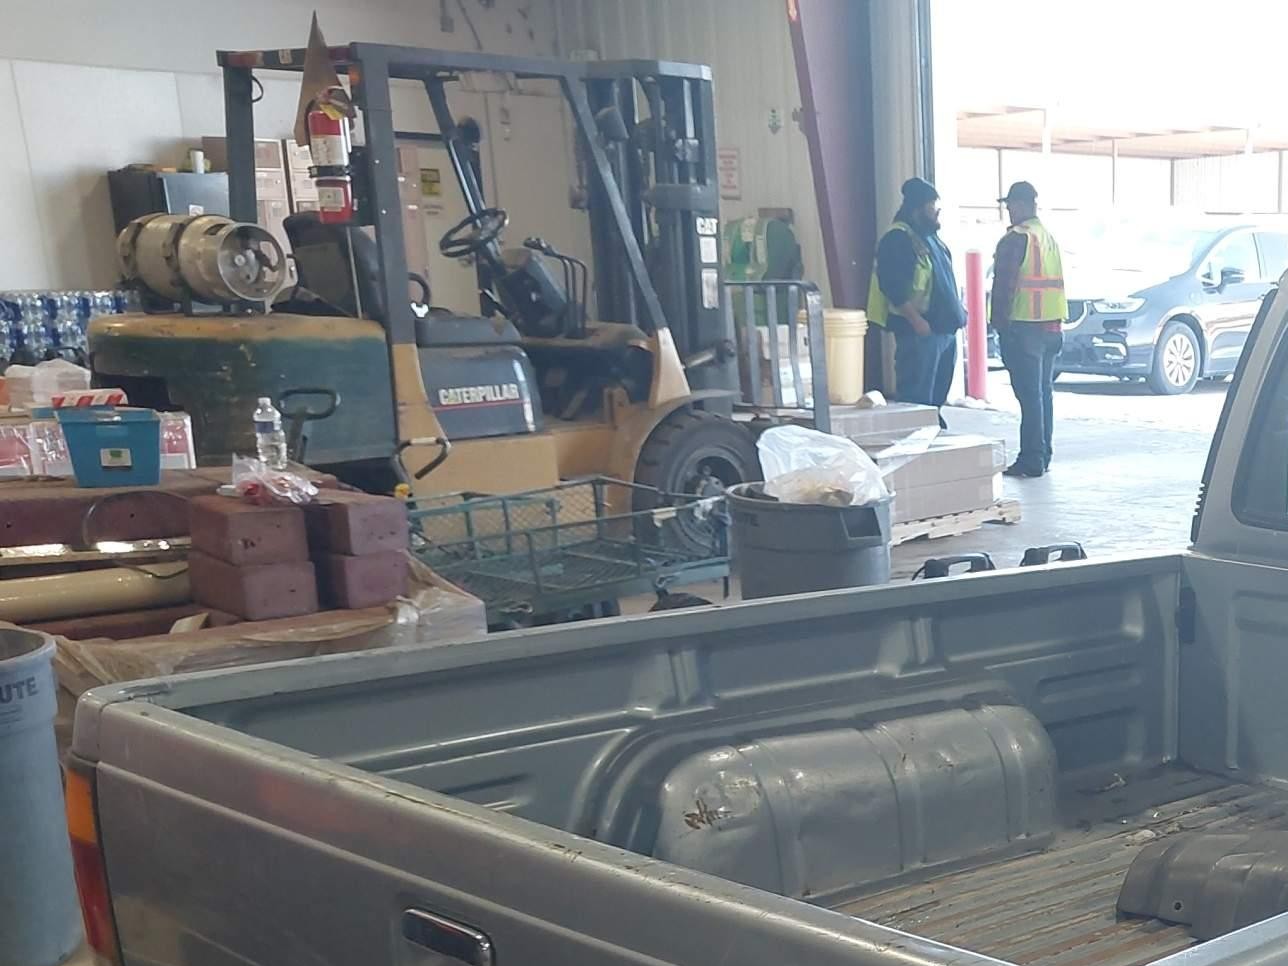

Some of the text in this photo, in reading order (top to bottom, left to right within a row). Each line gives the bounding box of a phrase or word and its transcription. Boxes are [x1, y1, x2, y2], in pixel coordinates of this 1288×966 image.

[696, 216, 718, 235] CAT
[438, 383, 519, 405] CATERPILLAR
[0, 676, 40, 704] UTE
